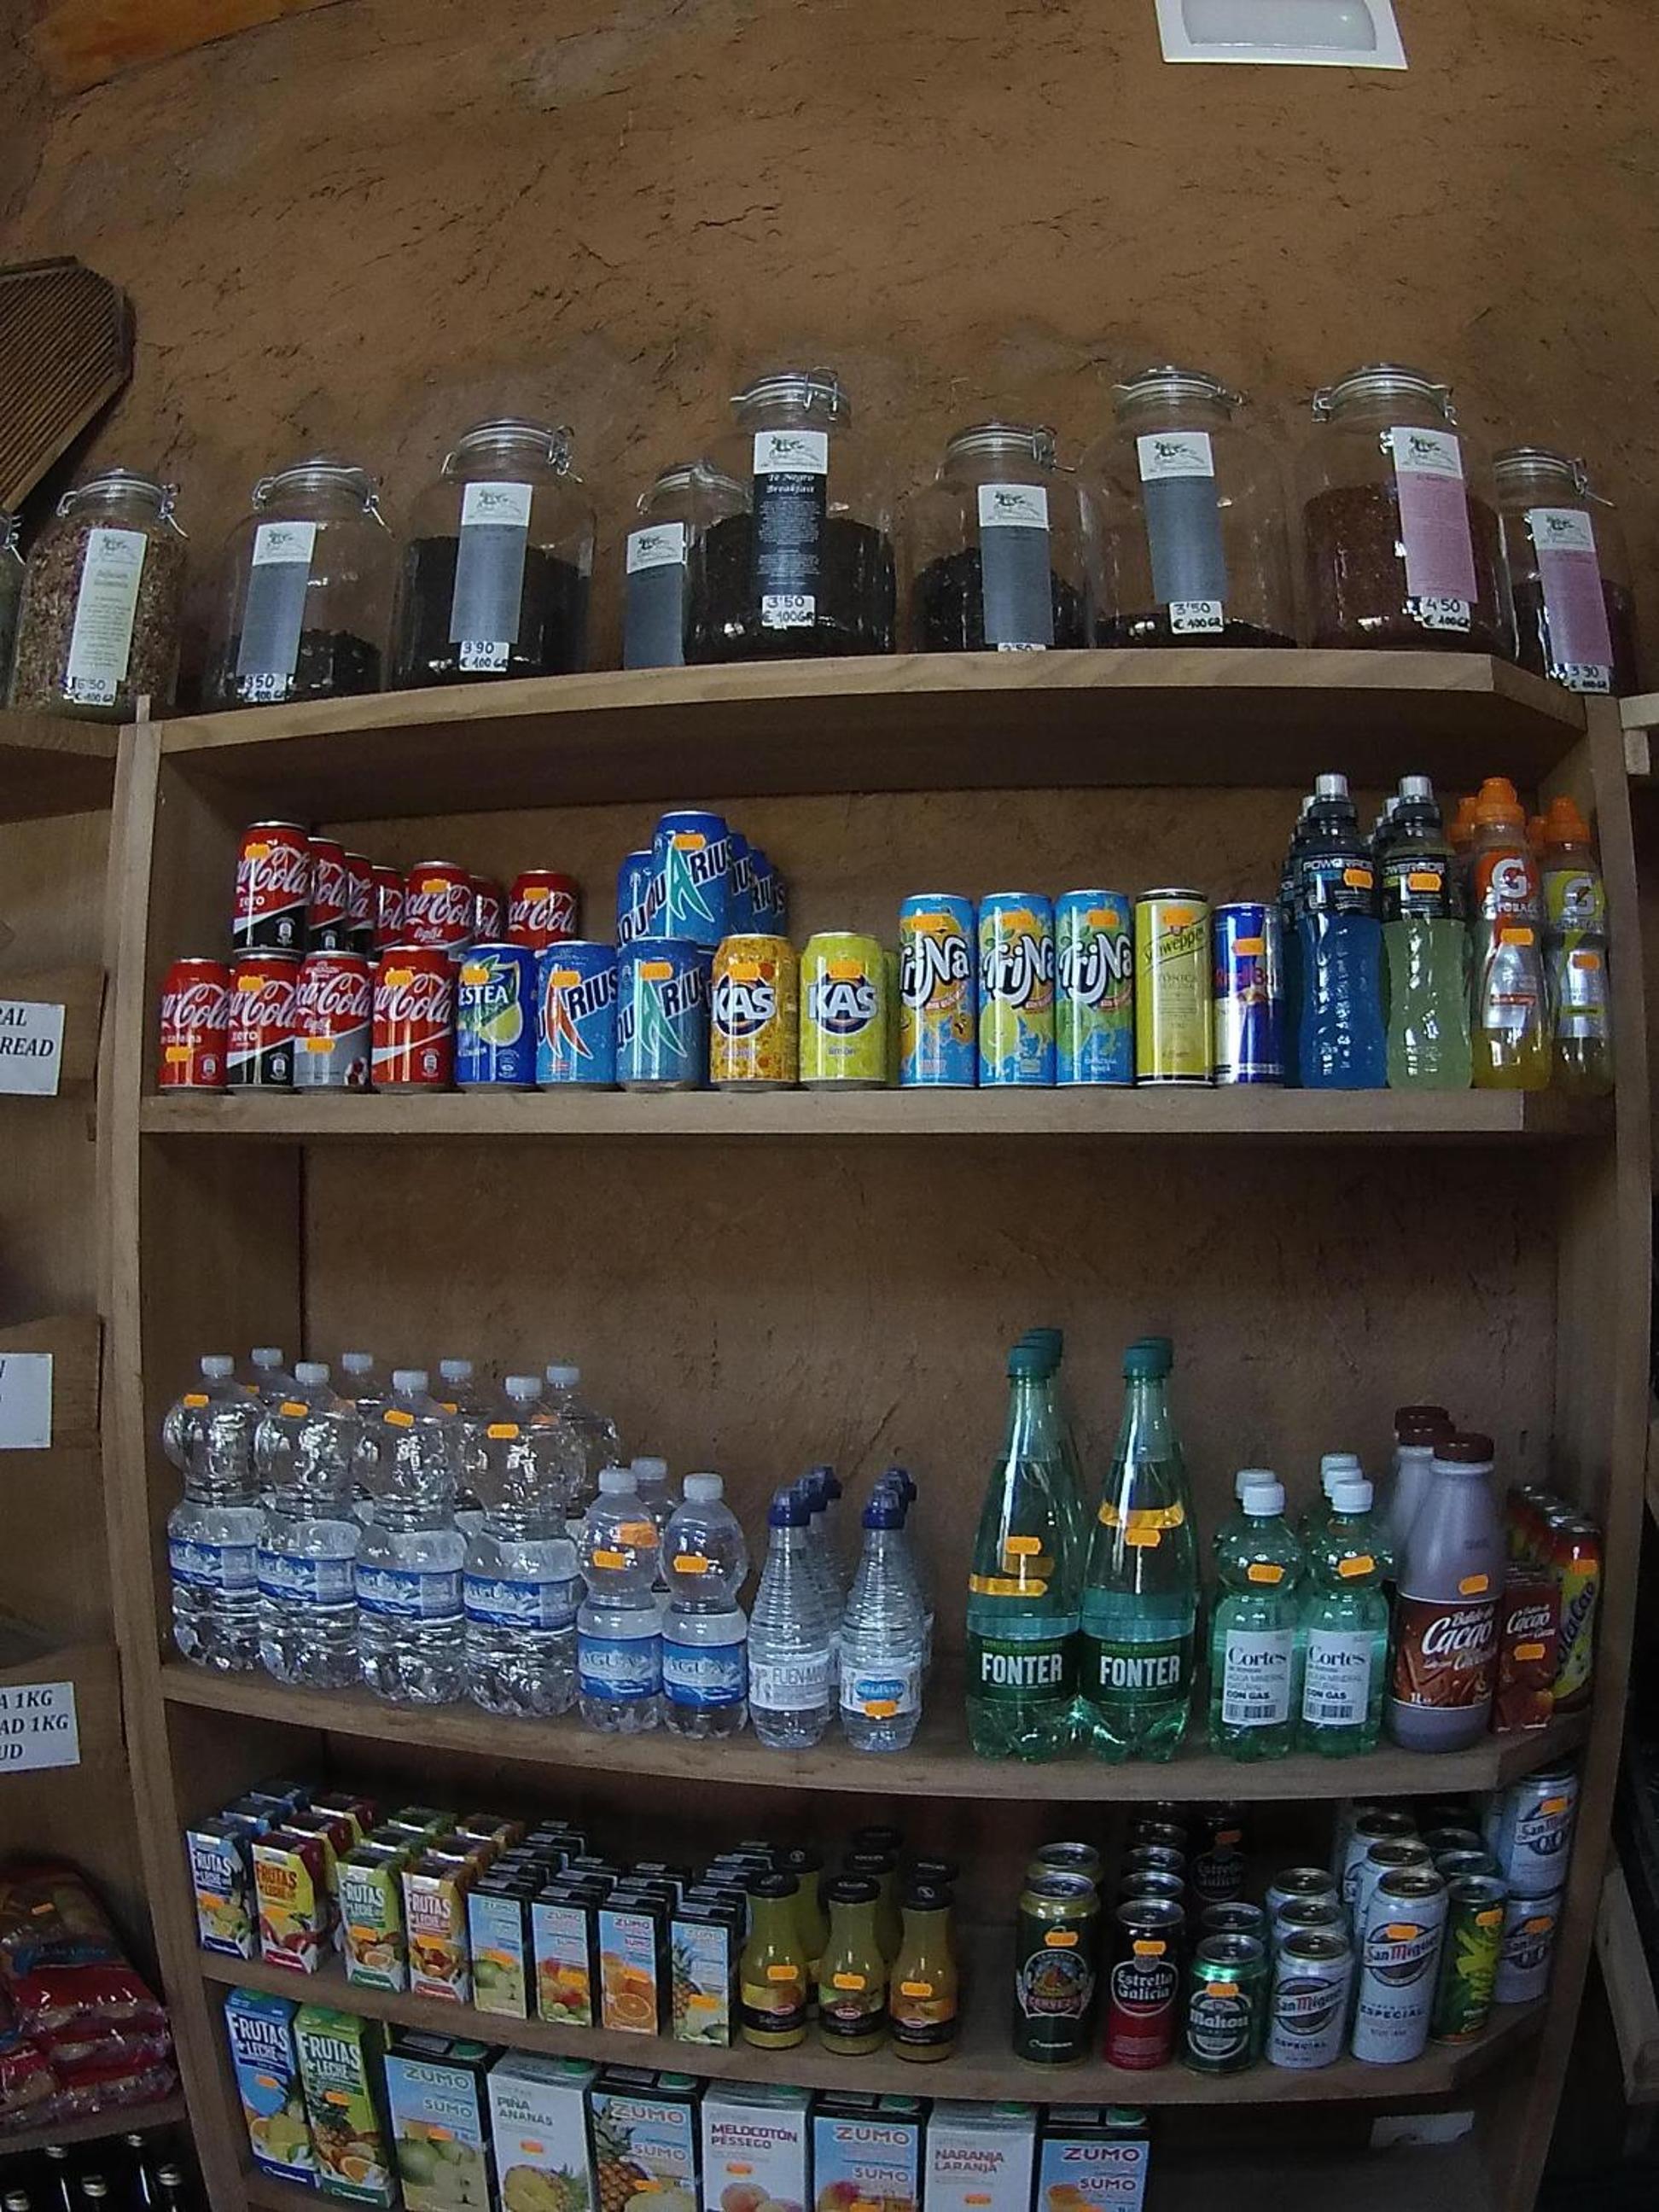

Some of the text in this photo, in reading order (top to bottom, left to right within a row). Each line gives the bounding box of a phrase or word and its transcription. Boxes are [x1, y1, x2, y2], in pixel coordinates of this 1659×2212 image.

[712, 984, 777, 1022] KAS
[809, 984, 878, 1021] KAS
[0, 1008, 27, 1027] AL
[230, 1030, 259, 1043] zero
[1506, 1610, 1551, 1634] Cacao
[1421, 1613, 1493, 1656] Cacao
[1227, 1645, 1288, 1666] Cortes
[1308, 1644, 1366, 1666] Cortes
[981, 1652, 1063, 1685] FONTER
[1099, 1655, 1181, 1688] FONTER
[16, 1689, 53, 1708] 1KG
[1226, 1690, 1271, 1700] CON GAS
[1325, 1690, 1348, 1700] GAS
[31, 1713, 69, 1732] 1KG
[614, 1916, 651, 1930] ZUMO
[1116, 1970, 1174, 1988] Estrella
[1117, 1987, 1171, 2001] Galicia
[1190, 2007, 1249, 2029] Mahou
[228, 2010, 289, 2052] FRUTAS
[298, 2030, 361, 2071] FRUTAS
[404, 2065, 469, 2091] ZUMO
[422, 2098, 473, 2119] SUMO
[610, 2101, 684, 2125] ZUMO
[711, 2122, 798, 2145] MELOCOTÓN
[835, 2125, 911, 2146] ZUMO
[634, 2143, 687, 2163] SUMO
[934, 2147, 1005, 2164] NARANJA
[1062, 2146, 1141, 2163] ZUMO
[853, 2166, 910, 2184] SUMO
[934, 2161, 998, 2175] LARANJA
[1079, 2177, 1138, 2192] SUMO
